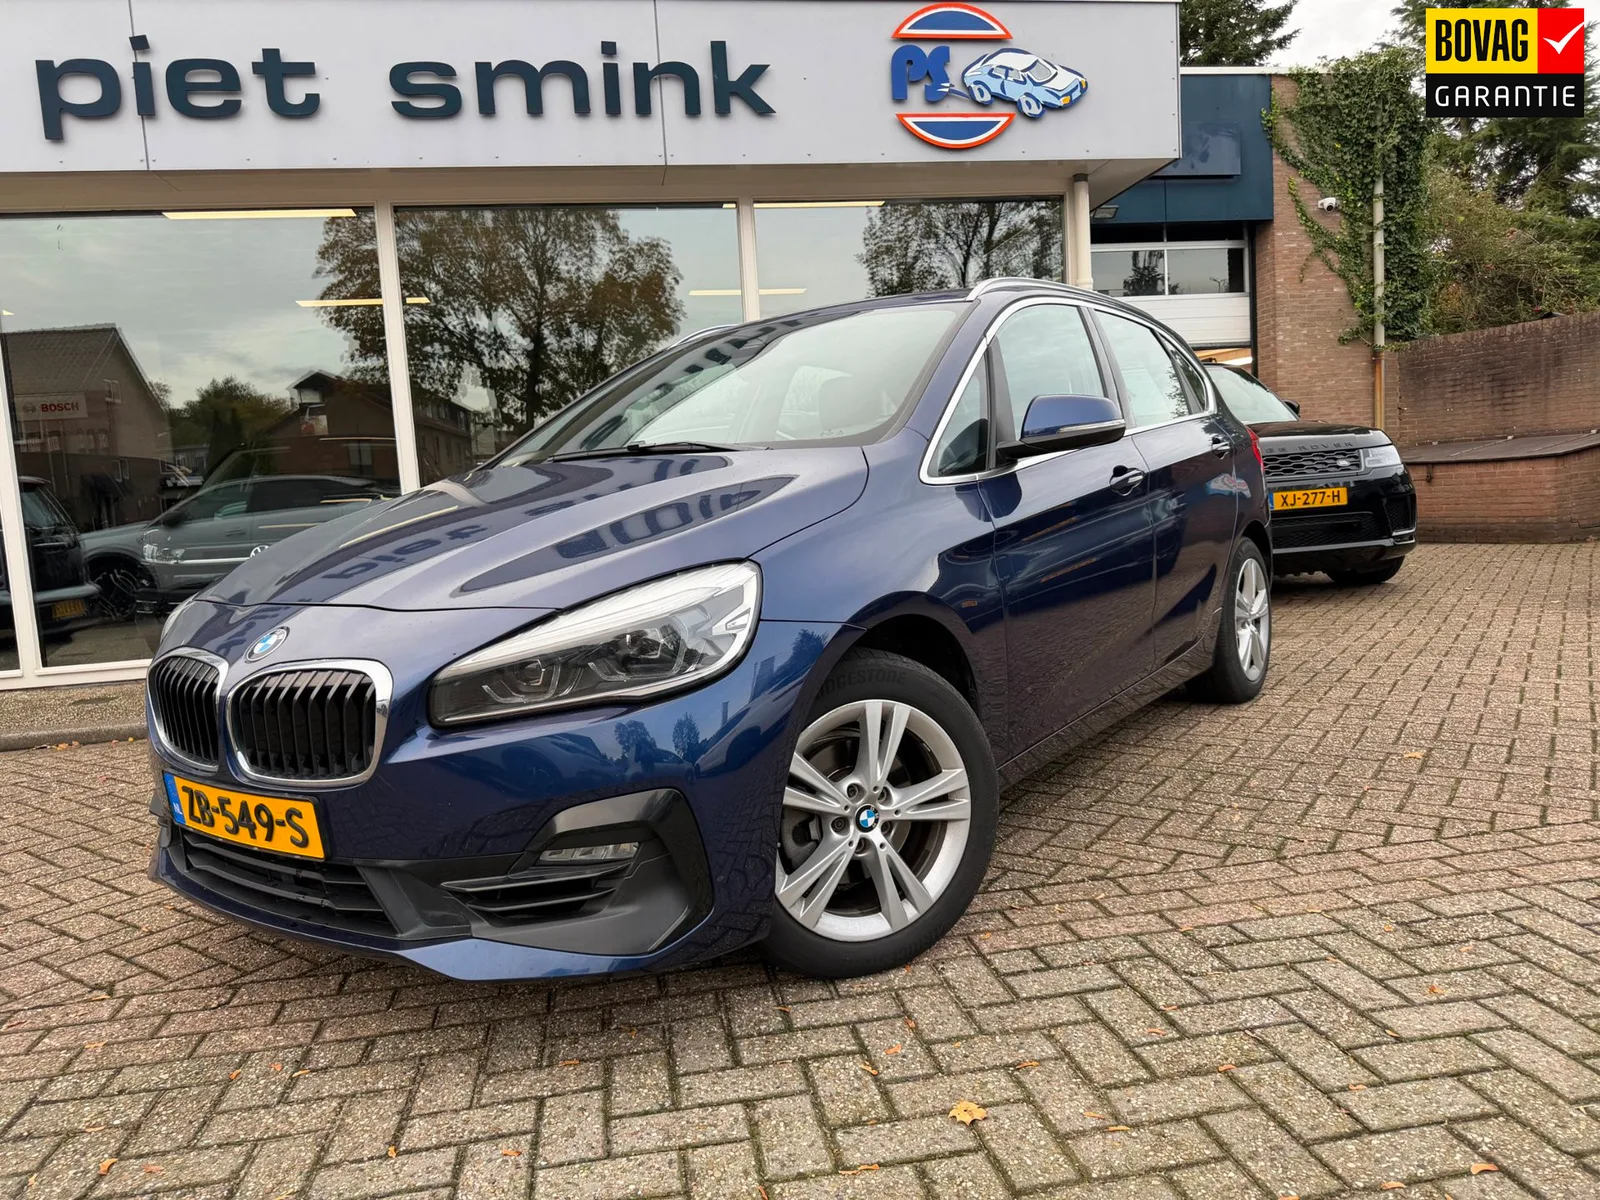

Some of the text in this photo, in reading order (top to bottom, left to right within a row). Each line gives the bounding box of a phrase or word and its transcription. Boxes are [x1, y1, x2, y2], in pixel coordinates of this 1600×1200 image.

[35, 35, 776, 140] piet smink
[41, 402, 80, 413] BOSCH
[1280, 489, 1341, 507] XJ-277-H
[181, 785, 309, 849] ZB-549-S
